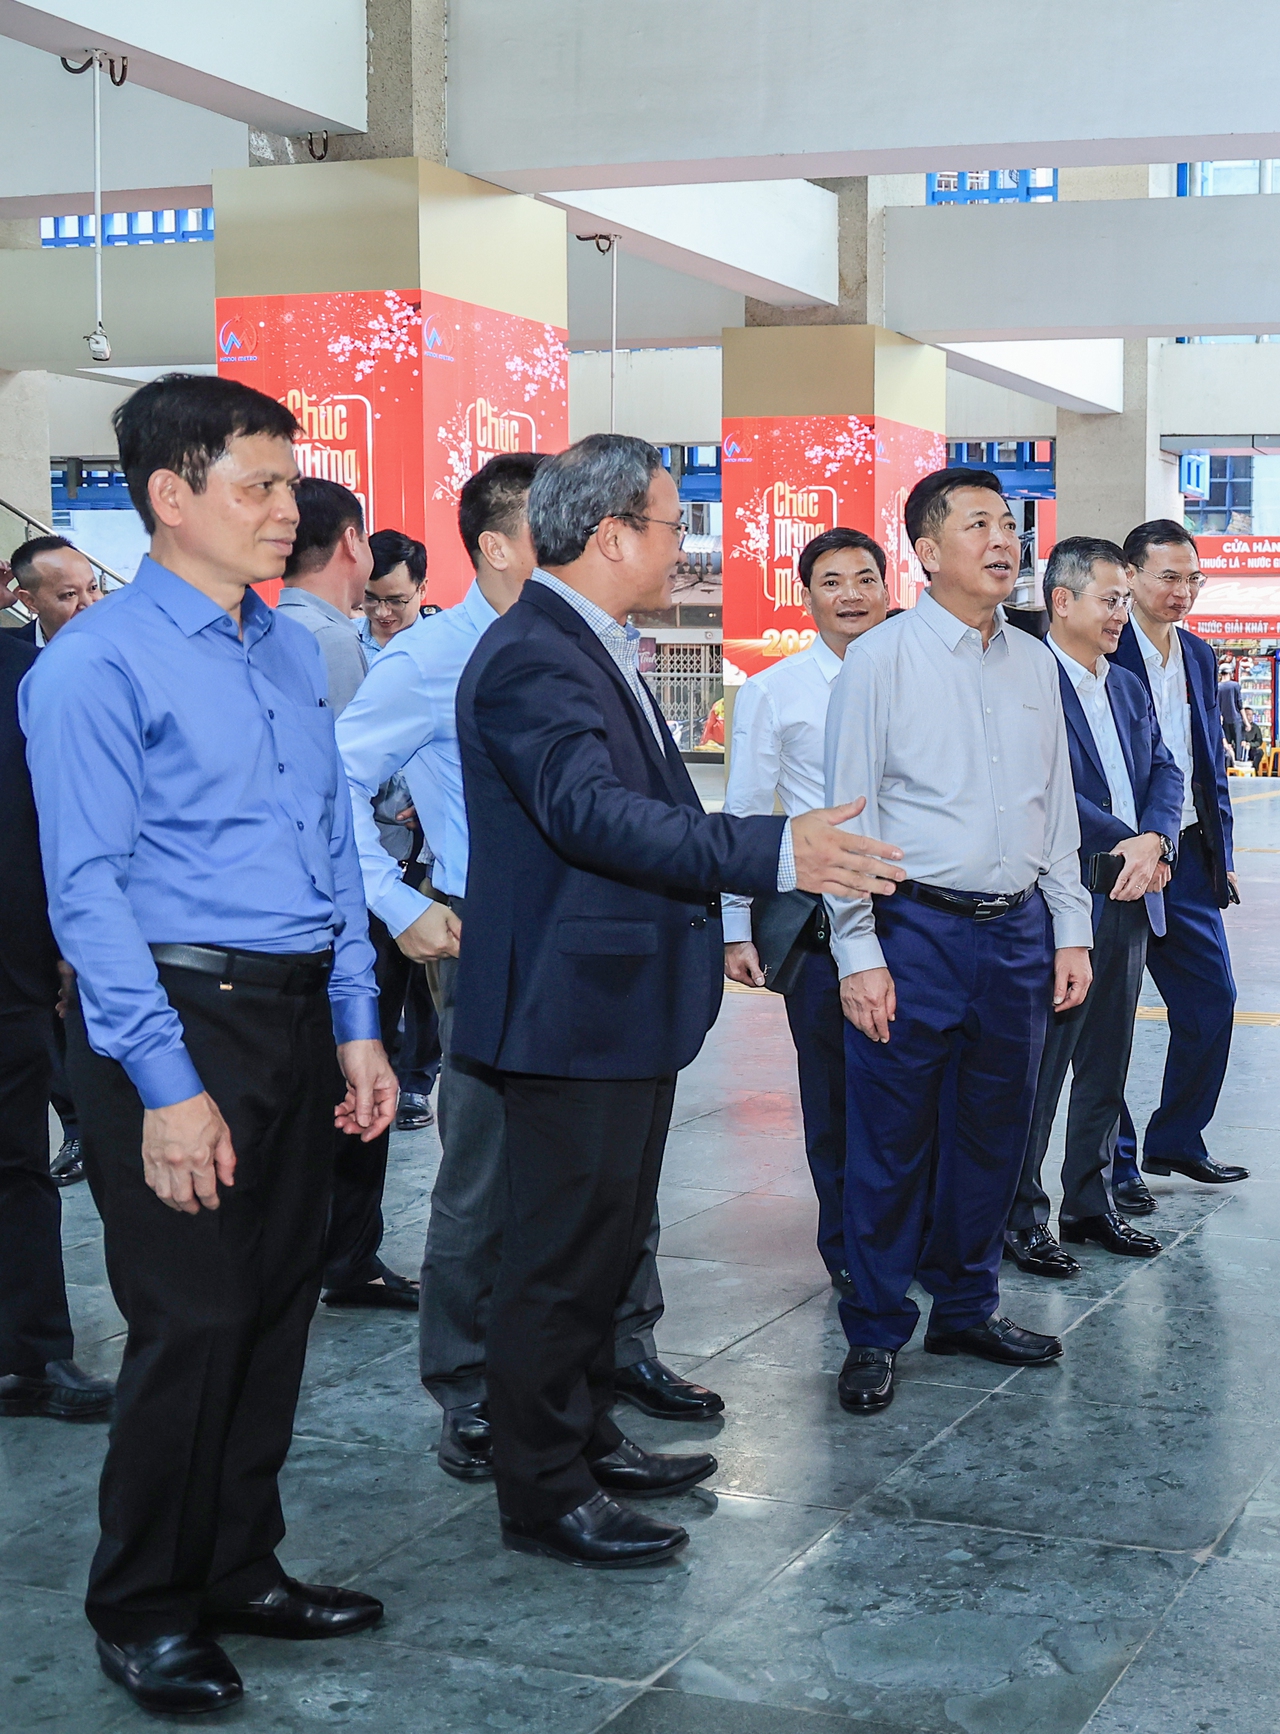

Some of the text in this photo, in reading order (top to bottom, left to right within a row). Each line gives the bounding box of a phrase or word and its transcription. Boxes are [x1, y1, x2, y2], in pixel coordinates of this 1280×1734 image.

[476, 397, 519, 453] Chúc
[774, 481, 819, 517] Chúc
[1222, 539, 1250, 553] CỬA
[1200, 555, 1227, 568] THUỐC
[1229, 556, 1240, 568] LÁ
[1247, 556, 1271, 568] NƯỚC
[1198, 619, 1222, 633] NƯỚC
[1225, 618, 1243, 633] GIẢI
[1245, 620, 1268, 633] KHÁT
